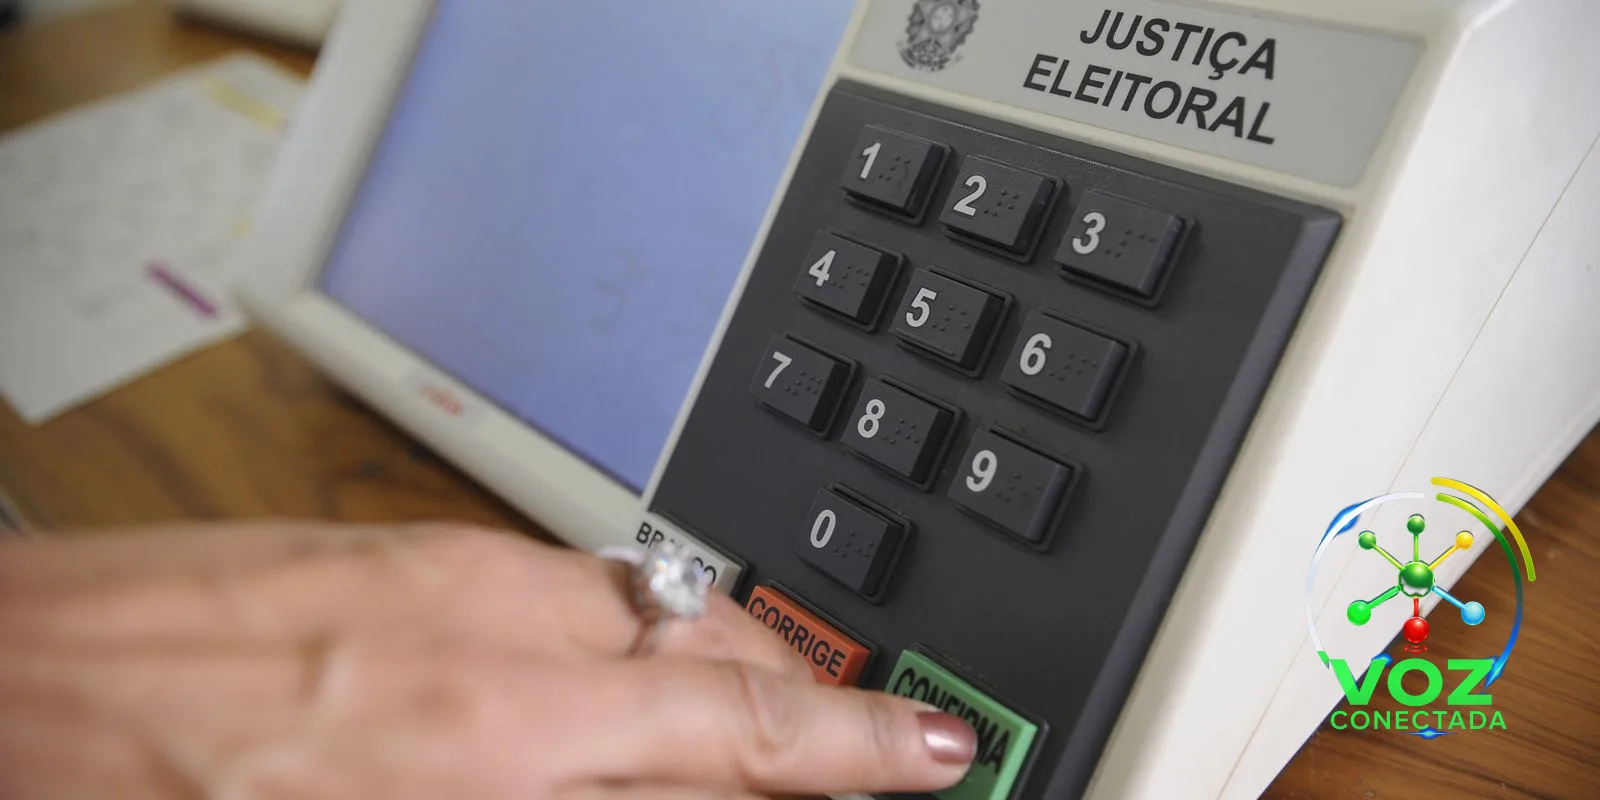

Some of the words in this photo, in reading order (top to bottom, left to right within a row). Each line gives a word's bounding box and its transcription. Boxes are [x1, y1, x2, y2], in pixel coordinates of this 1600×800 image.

[1079, 9, 1276, 81] JUSTIÇA
[1023, 54, 1276, 145] ELEITORAL
[860, 142, 882, 179] 1
[953, 174, 987, 217] 2
[1072, 211, 1106, 255] 3
[808, 249, 836, 287] 4
[905, 287, 937, 328] 5
[764, 351, 793, 389] 7
[1019, 332, 1052, 376] 6
[857, 398, 886, 439] 8
[965, 449, 998, 493] 9
[810, 509, 837, 549] 0
[636, 521, 717, 585] BRO
[749, 596, 847, 678] CORRIGE
